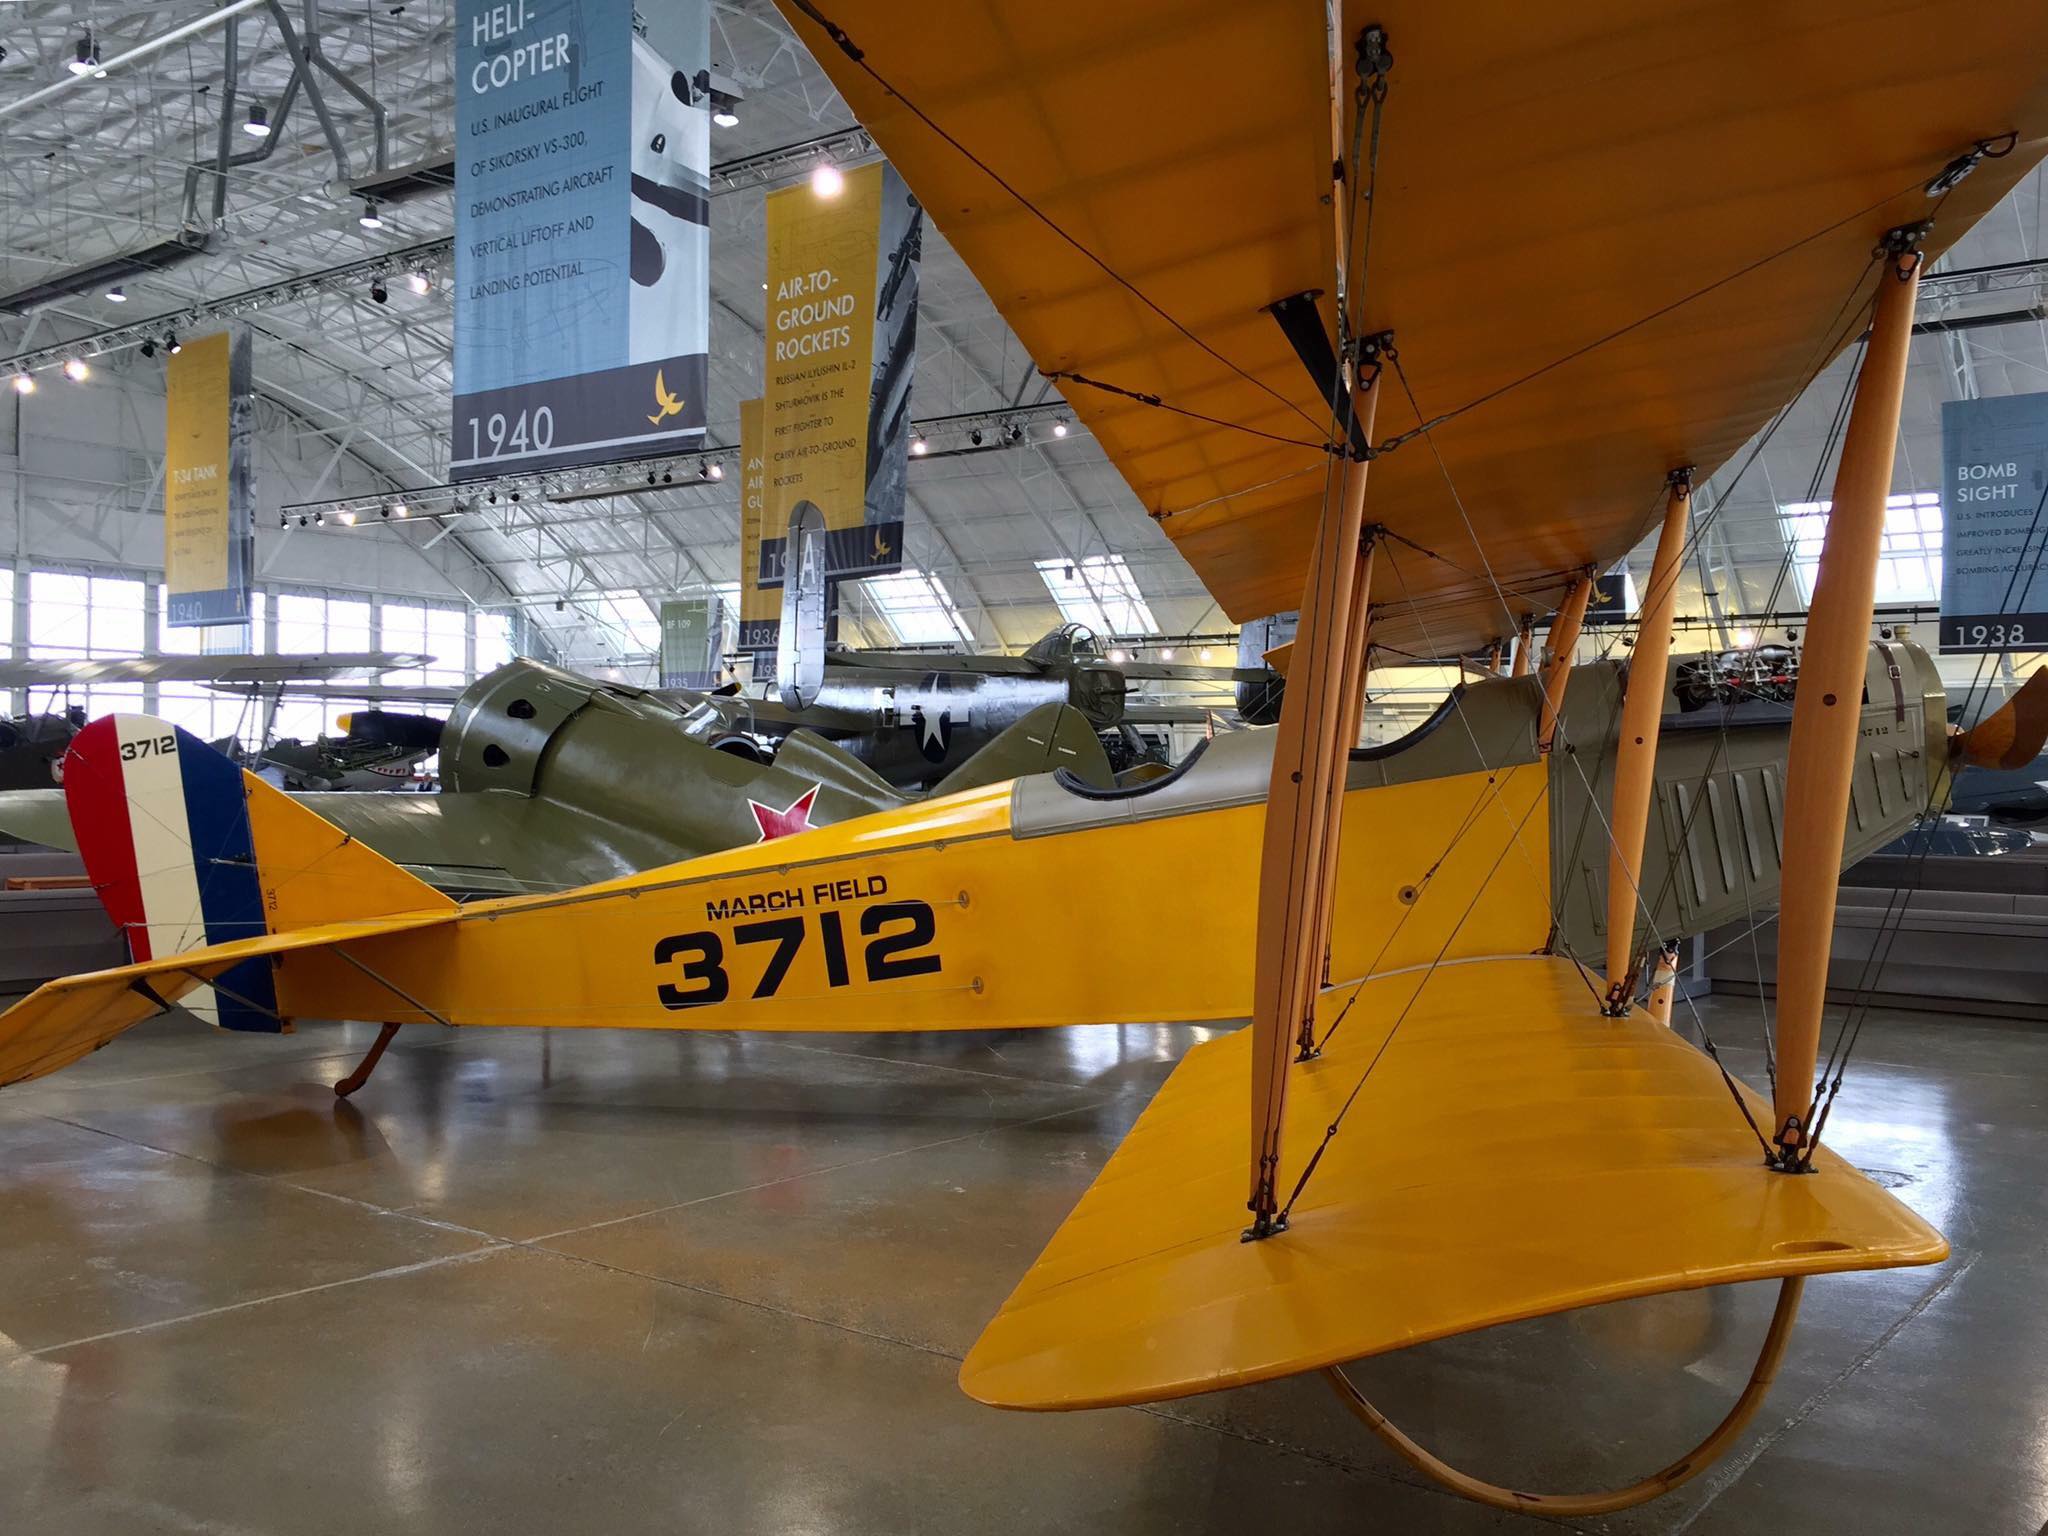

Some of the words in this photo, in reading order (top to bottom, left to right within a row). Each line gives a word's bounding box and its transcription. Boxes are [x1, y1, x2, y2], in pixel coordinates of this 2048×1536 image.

[472, 0, 536, 47] HELI-
[471, 33, 571, 95] COPTER
[471, 118, 492, 136] U.S.
[494, 99, 560, 130] INAUGURAL
[563, 81, 604, 107] FLIGHT
[471, 161, 487, 178] OF
[489, 143, 541, 173] SIKORSKY
[544, 131, 588, 156] VS-300,
[471, 181, 560, 218] DEMONSTRATING
[563, 166, 614, 196] AIRCRAFT
[470, 235, 519, 259] VERTICAL
[521, 223, 565, 251] LIFTOFF
[568, 215, 595, 236] AND
[470, 275, 521, 300] LANDING
[523, 261, 585, 288] POTENTIAL
[776, 270, 839, 301] AIR-TO-
[776, 295, 855, 330] GROUND
[776, 326, 850, 361] ROCKETS
[775, 370, 807, 385] RUSSIAN
[830, 387, 845, 400] THE
[468, 406, 555, 461] 1940
[823, 416, 834, 427] TO
[1957, 463, 2018, 481] BOMB
[1957, 484, 2018, 503] SIGHT
[1975, 508, 2034, 519] INTRODUCES
[1956, 529, 2002, 538] IMPROVED
[1956, 546, 1993, 557] GREATLY
[1995, 544, 2048, 554] INCRESING
[1956, 565, 2000, 575] BOMBING
[172, 601, 202, 623] 1940
[1956, 624, 2025, 646] 1938
[759, 664, 778, 679] 193
[121, 735, 177, 761] 3712
[266, 888, 279, 911] 3712
[706, 888, 805, 921] MARCH
[813, 875, 888, 905] FIELD
[654, 899, 942, 1011] 3712
